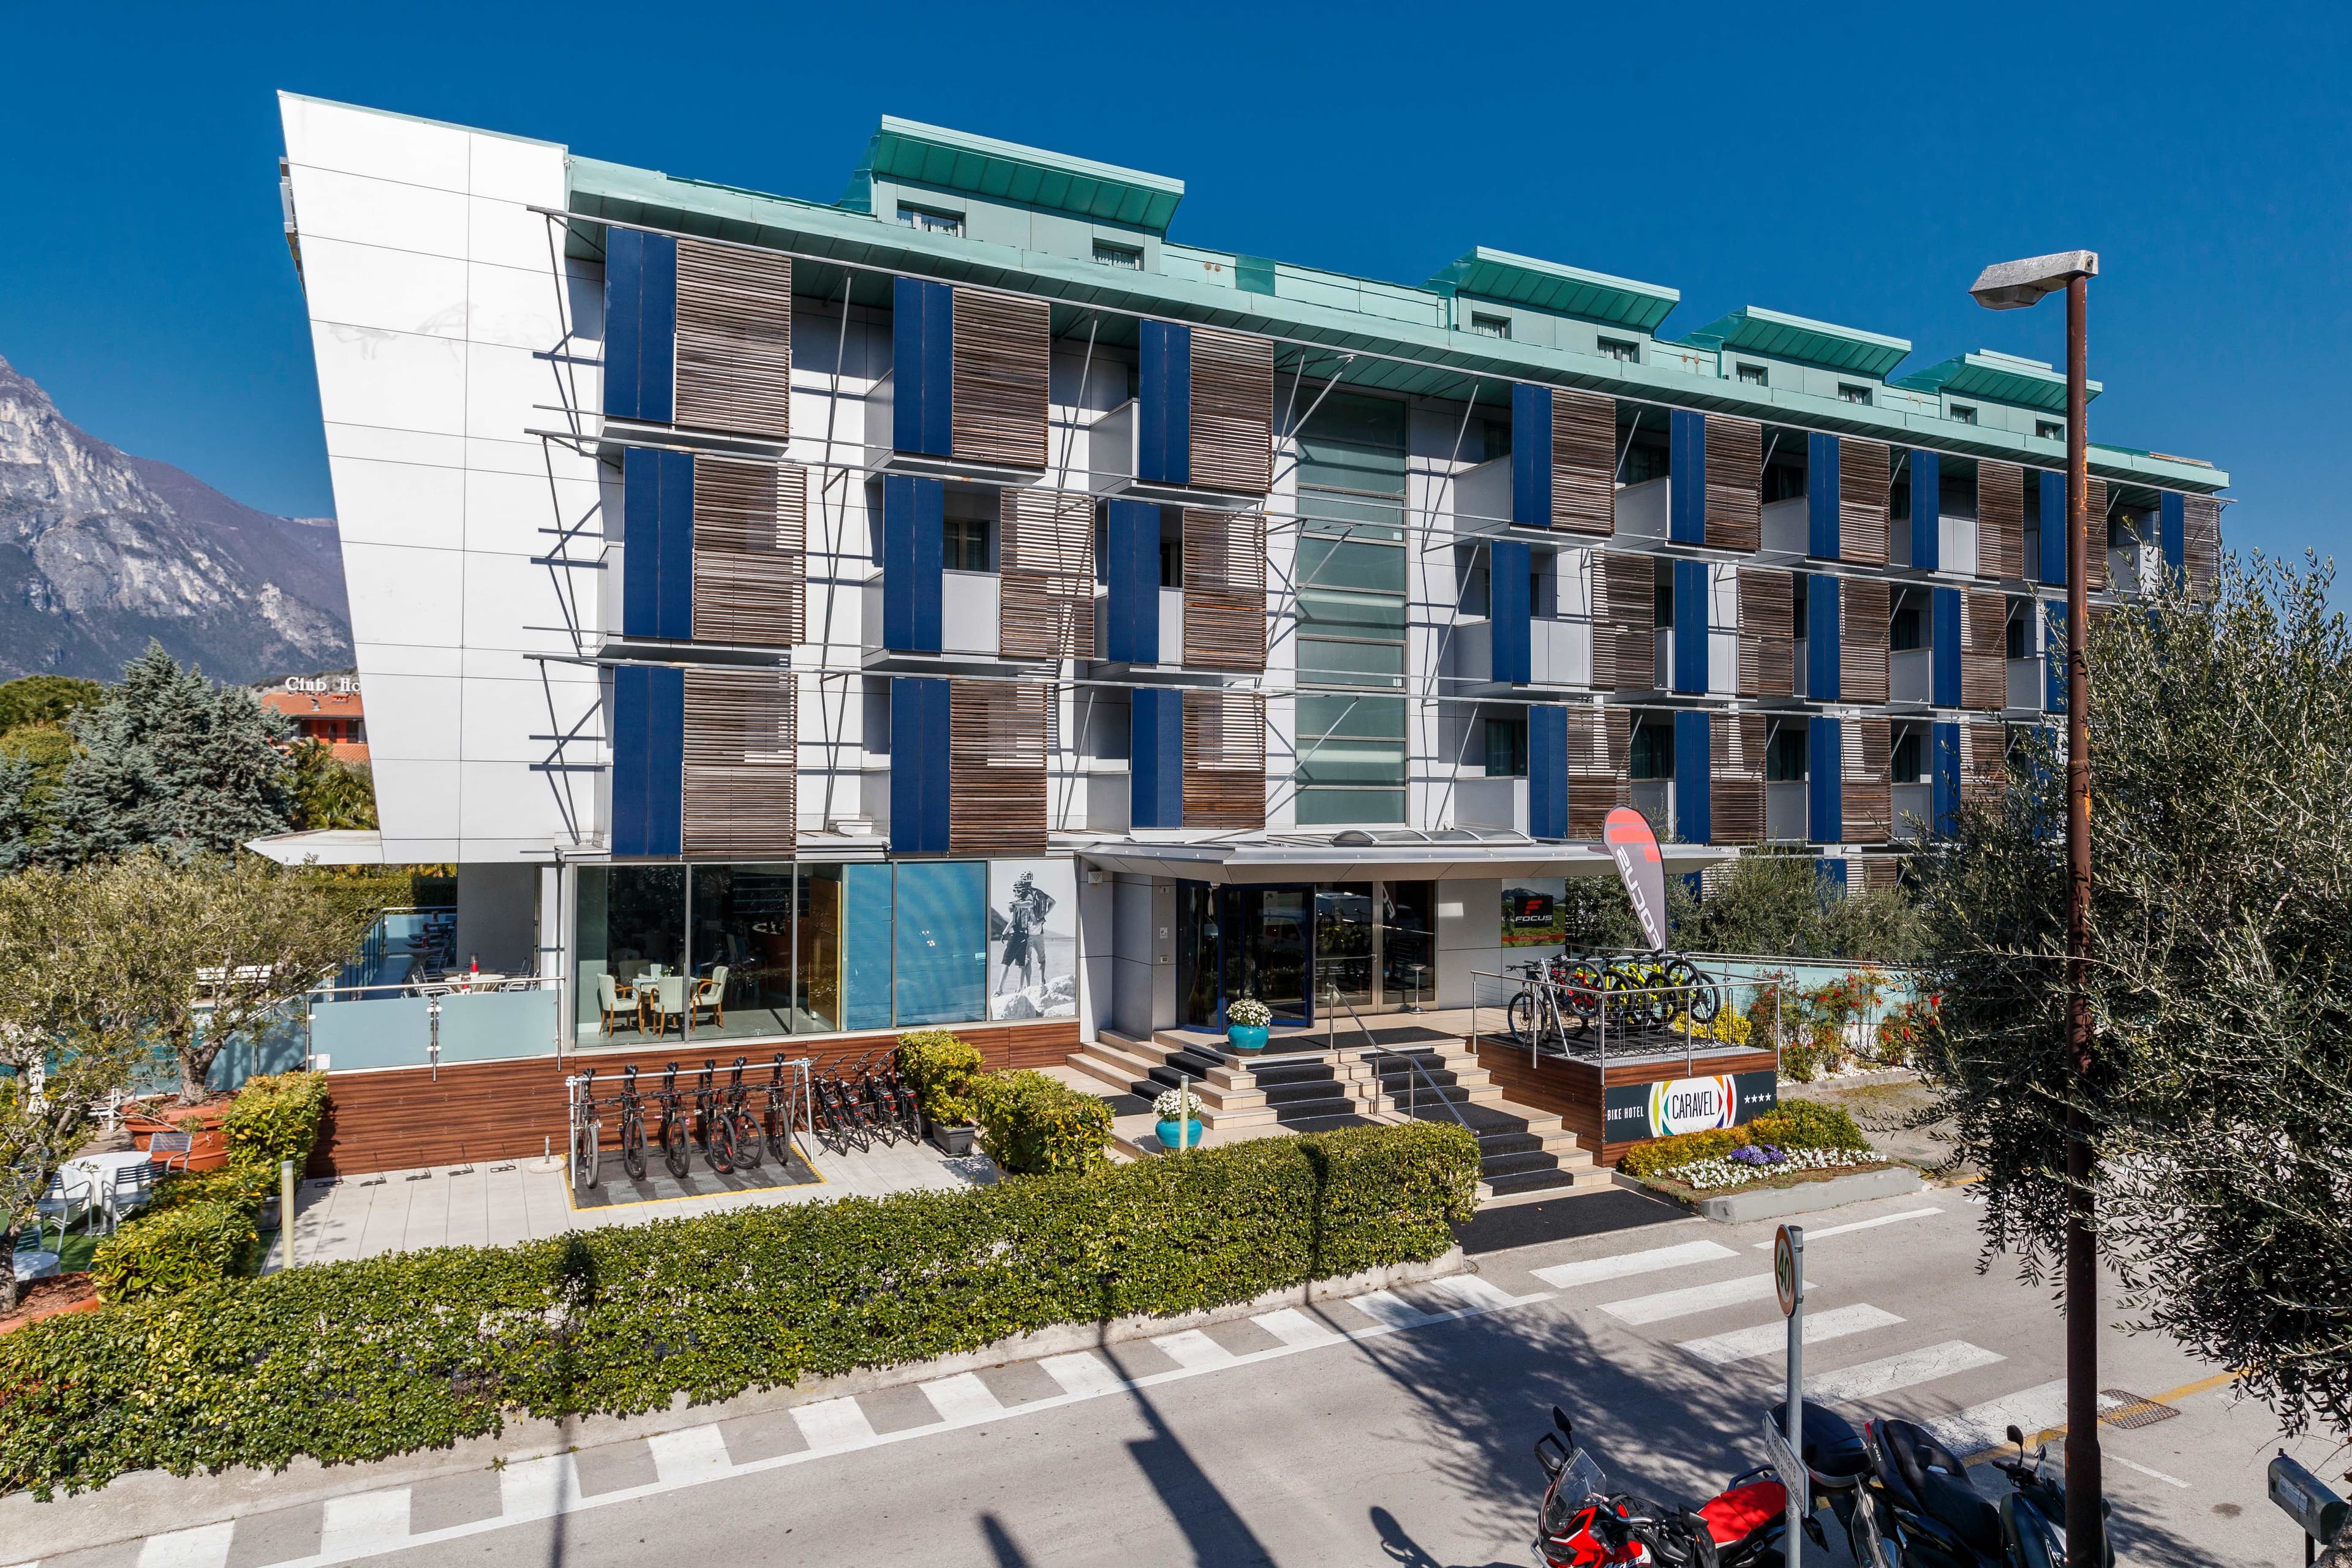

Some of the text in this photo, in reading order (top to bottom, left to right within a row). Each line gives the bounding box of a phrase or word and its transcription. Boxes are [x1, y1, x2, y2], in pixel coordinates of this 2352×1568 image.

[285, 676, 361, 692] Club Ho
[1607, 1106, 1644, 1121] BIKE HOTEL
[1672, 1091, 1715, 1120] CARAVEL
[1778, 1248, 1791, 1297] 40
[1771, 1431, 1797, 1479] rallentare
